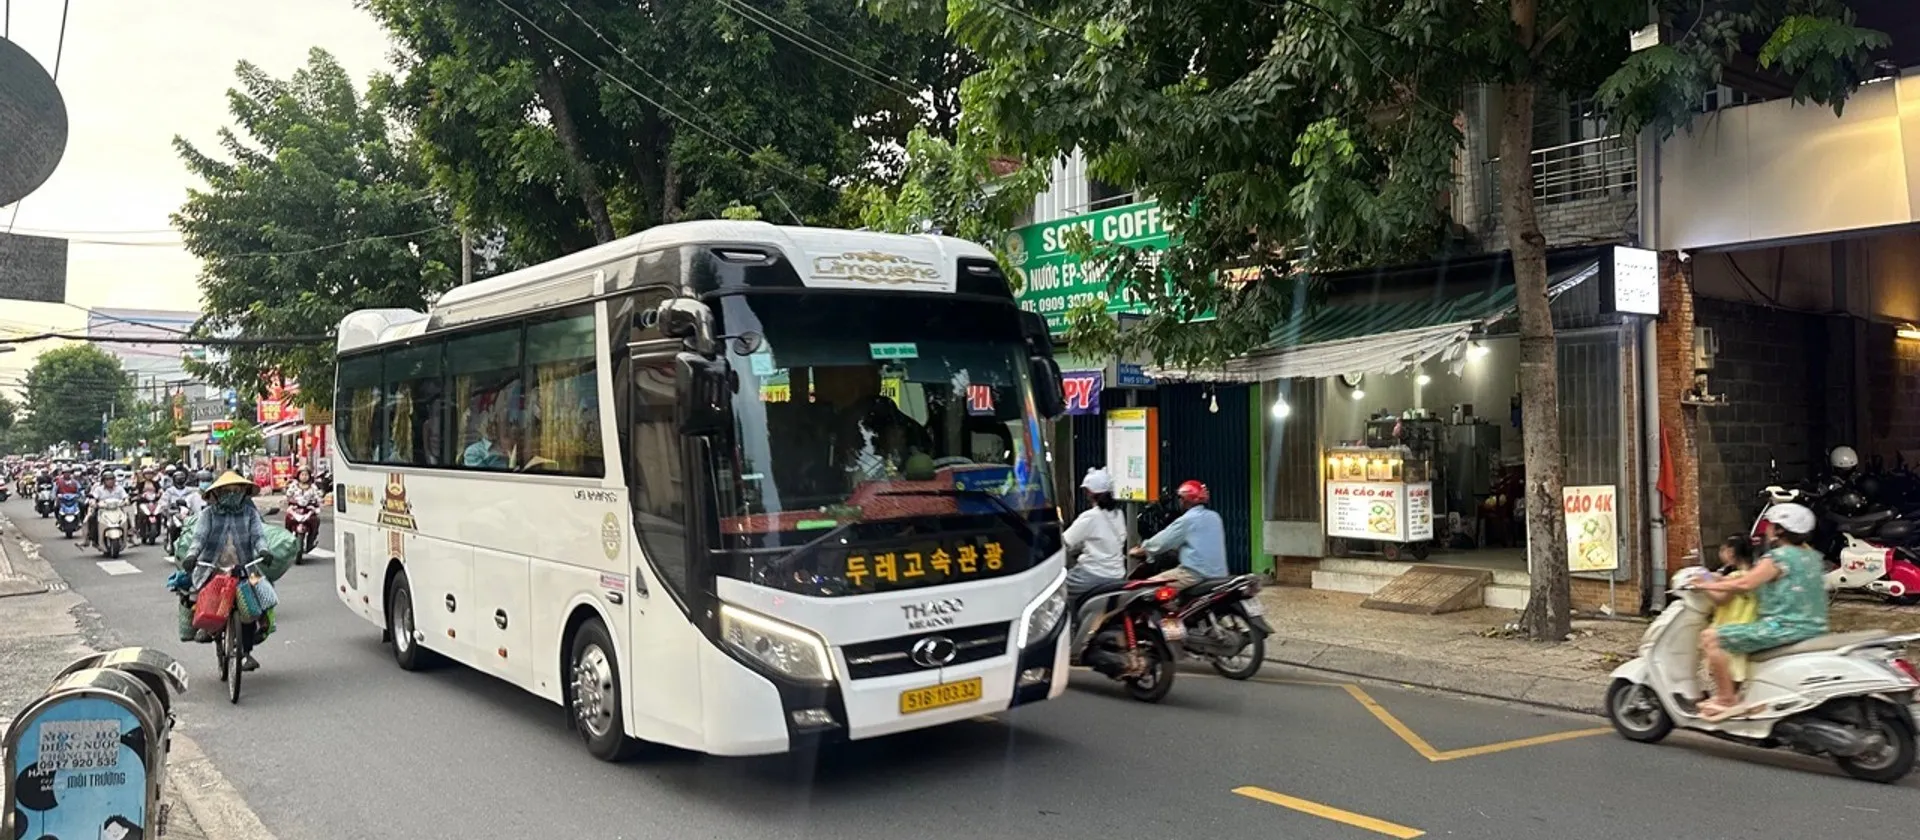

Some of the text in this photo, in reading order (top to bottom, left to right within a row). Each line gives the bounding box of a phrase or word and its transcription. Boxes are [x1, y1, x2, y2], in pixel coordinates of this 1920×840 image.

[1038, 296, 1065, 312] 0909
[1378, 490, 1395, 498] 4K
[1565, 488, 1613, 513] CẢO 4K
[845, 542, 1004, 586] 두레고속관광
[900, 598, 964, 620] THACO
[72, 758, 94, 768] 920
[96, 757, 118, 767] 535
